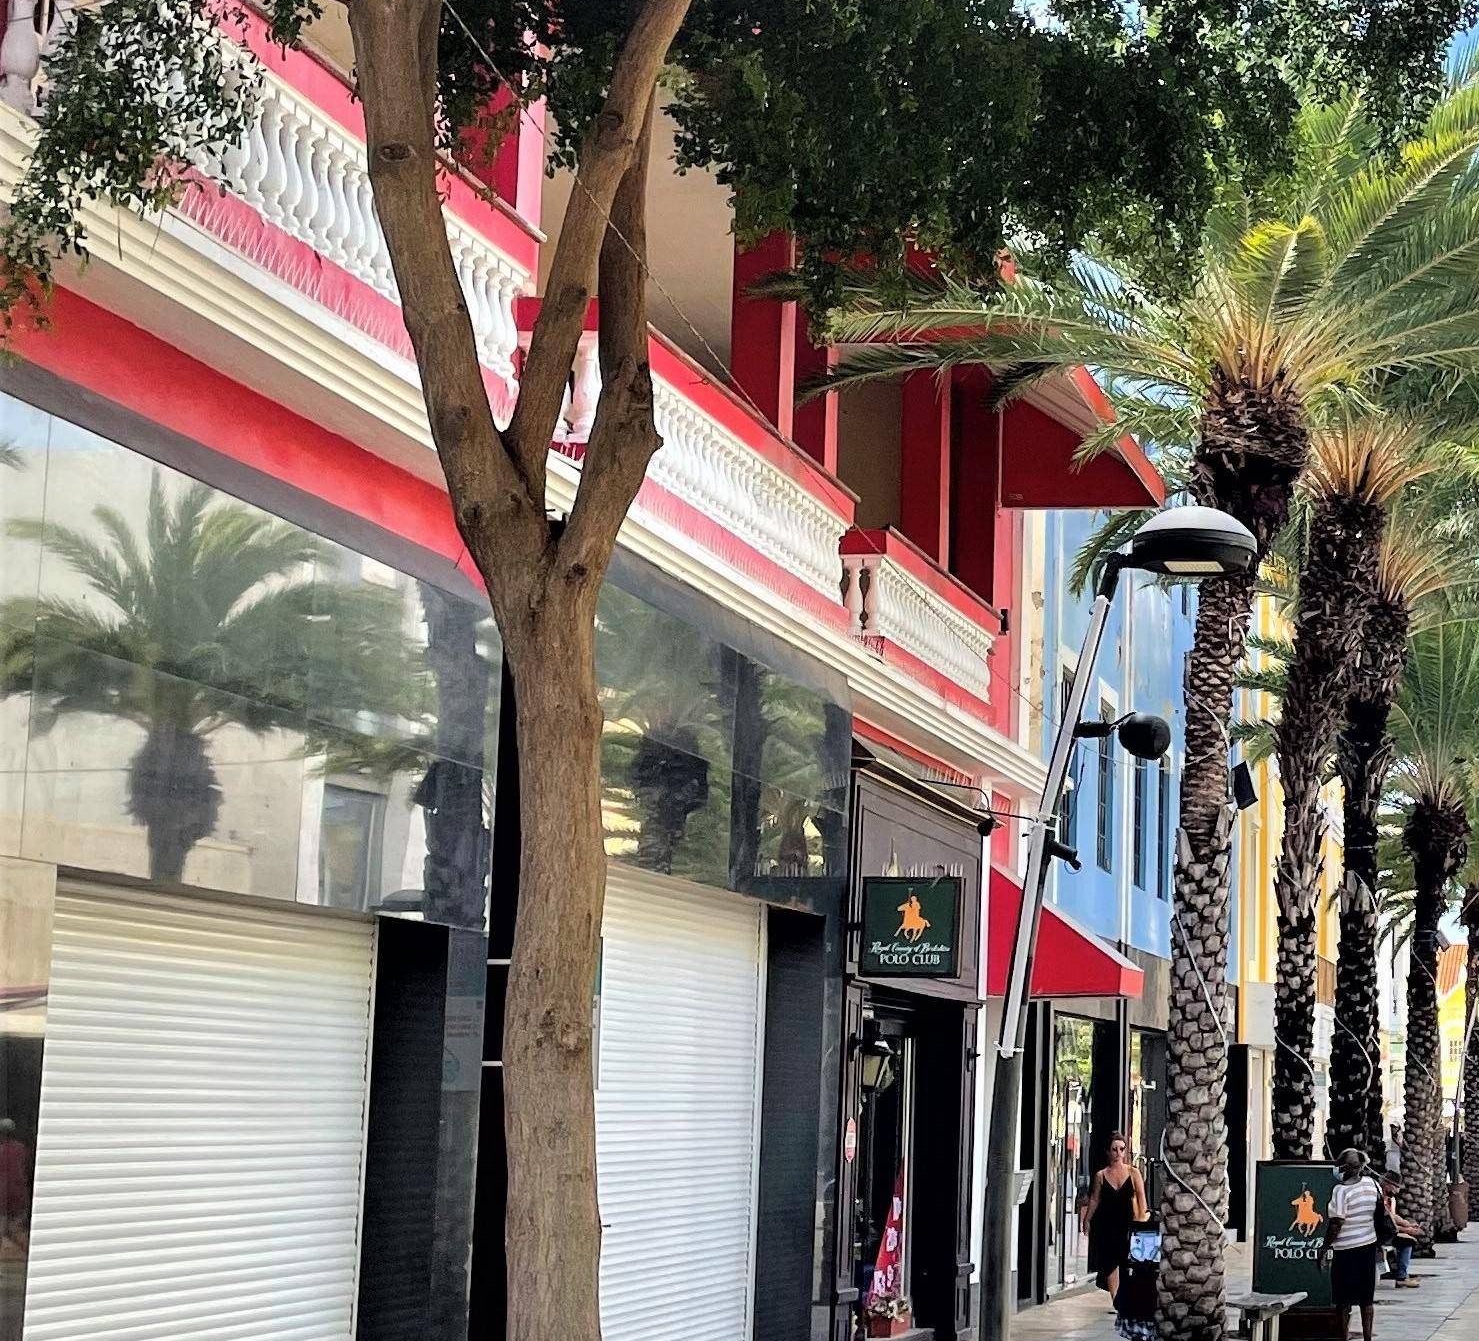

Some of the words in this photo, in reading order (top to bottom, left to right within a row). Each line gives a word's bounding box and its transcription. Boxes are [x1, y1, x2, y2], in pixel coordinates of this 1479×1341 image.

[880, 954, 909, 964] POLO
[912, 954, 940, 964] CLUB
[1274, 1248, 1303, 1259] POLO
